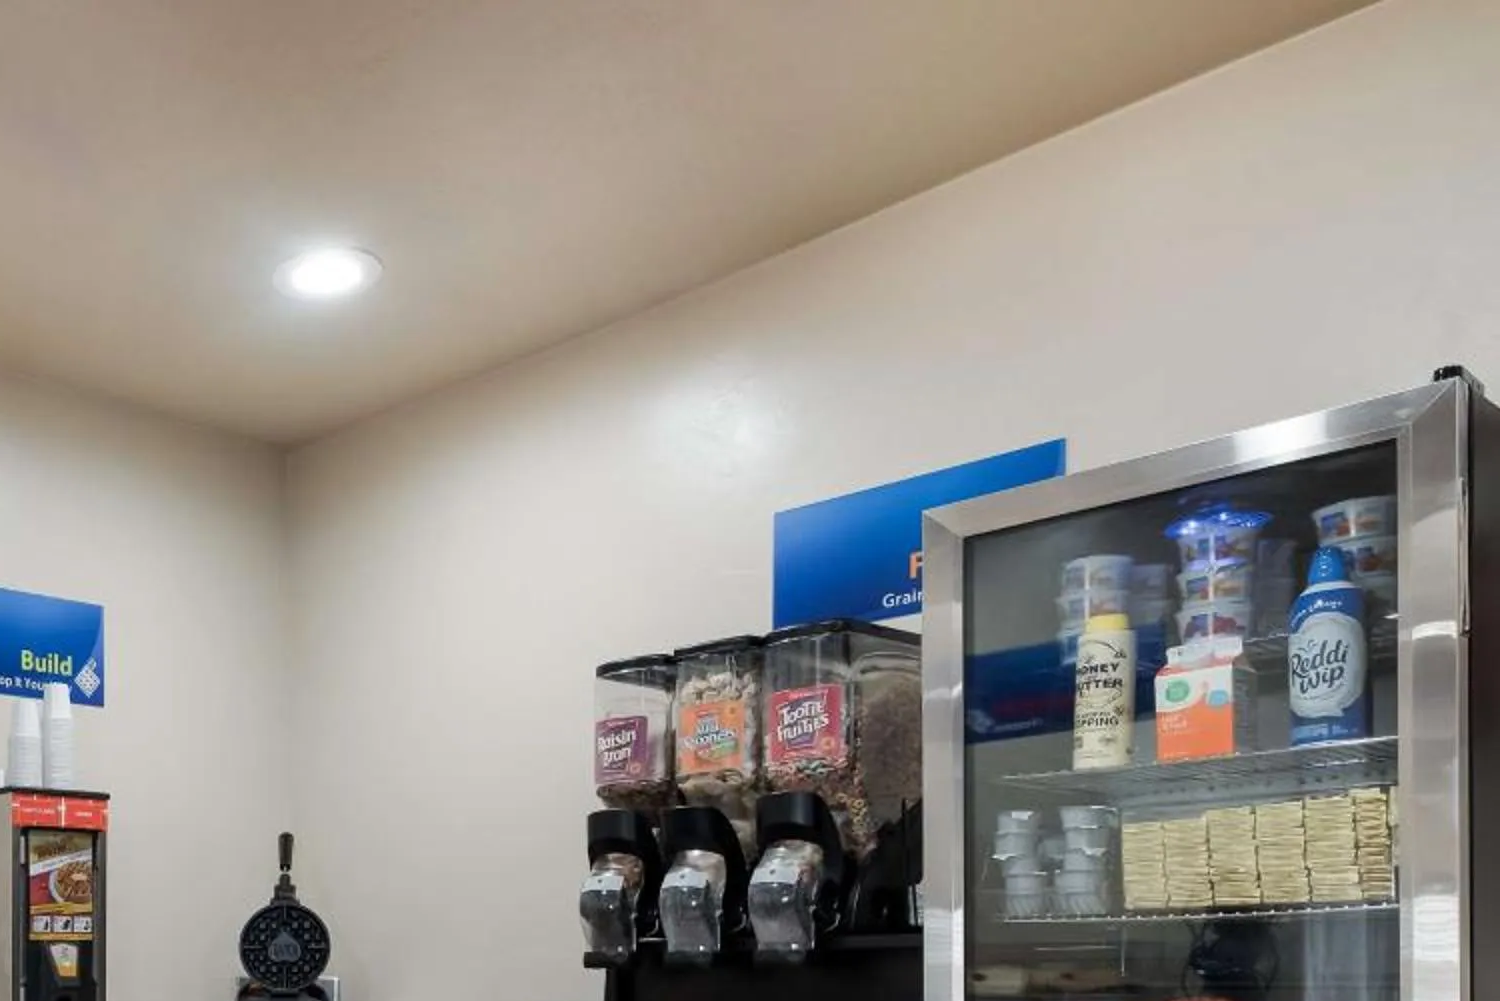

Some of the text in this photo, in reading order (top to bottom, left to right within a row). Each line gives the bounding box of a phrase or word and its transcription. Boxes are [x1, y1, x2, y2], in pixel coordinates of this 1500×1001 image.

[21, 649, 73, 677] Build
[1290, 640, 1349, 687] Reddi
[1076, 678, 1123, 690] UTTER
